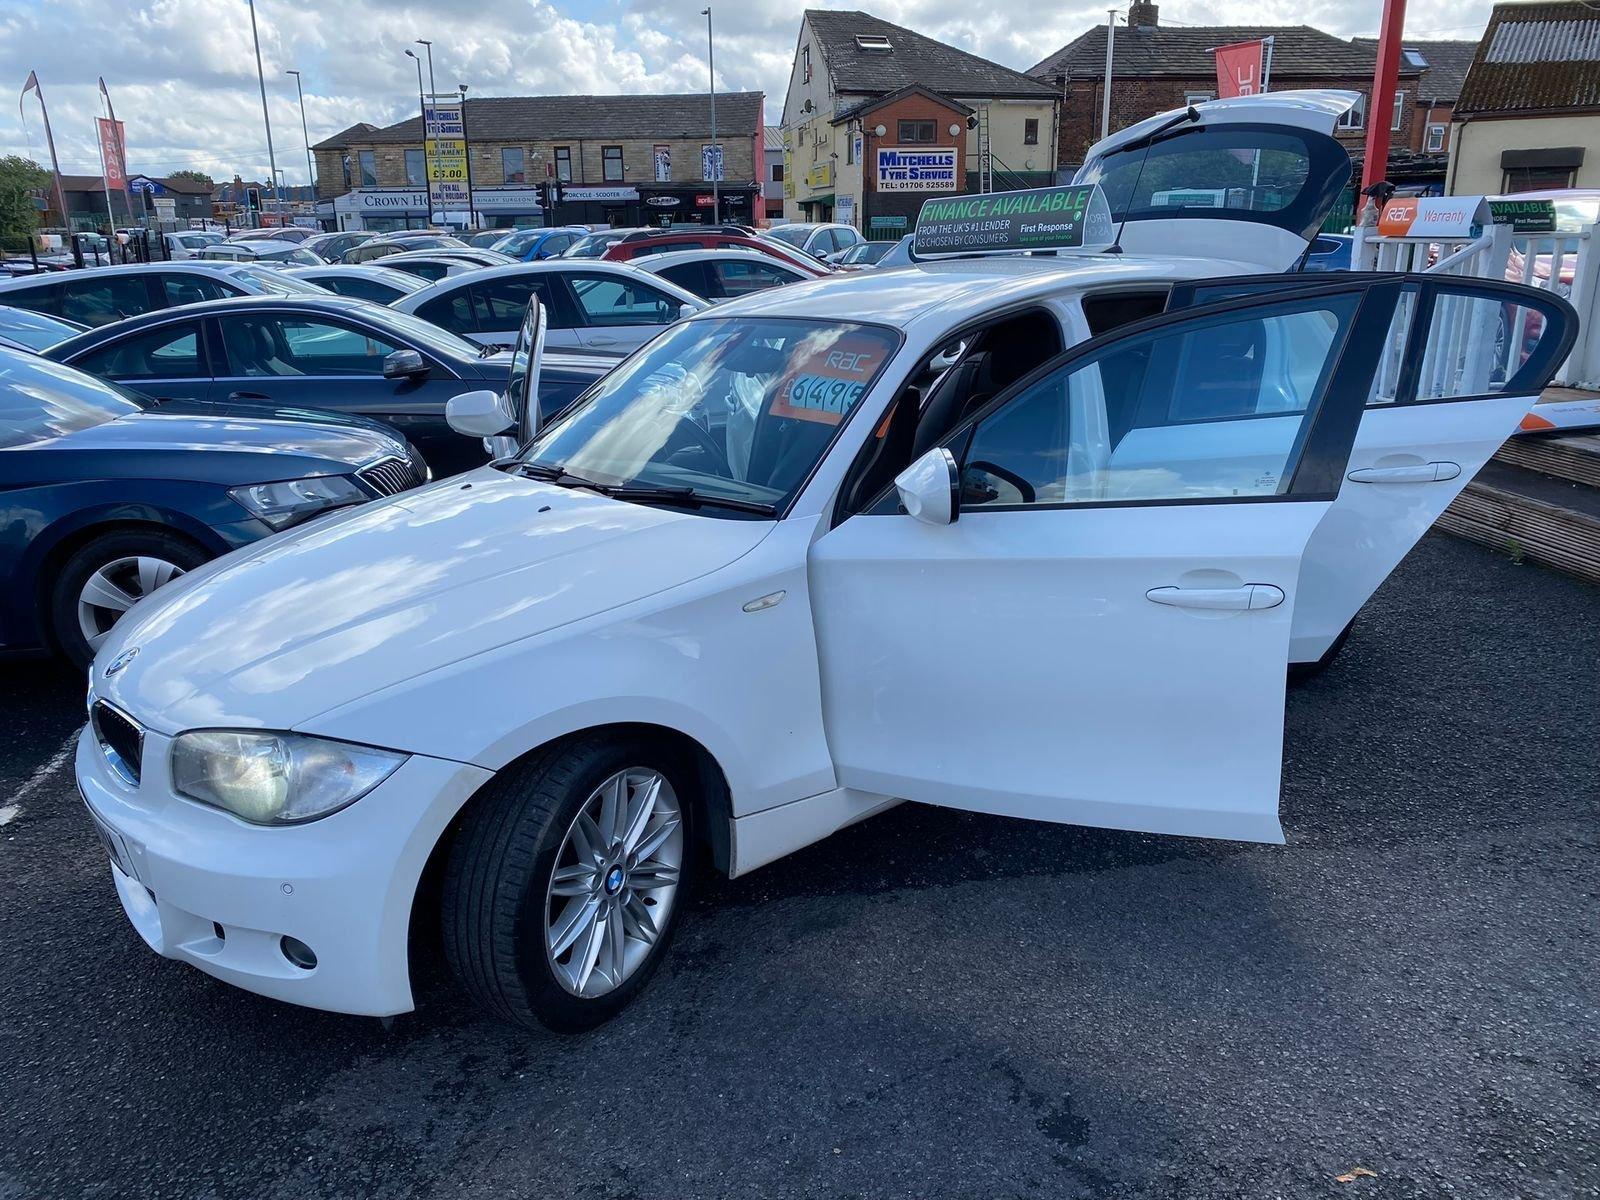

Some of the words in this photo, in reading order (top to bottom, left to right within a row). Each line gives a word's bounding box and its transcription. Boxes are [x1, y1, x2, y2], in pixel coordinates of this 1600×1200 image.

[426, 109, 459, 121] MTCHELLS
[441, 122, 462, 133] SERVICE
[879, 151, 953, 166] MITCHELLS
[879, 168, 907, 180] TYRE
[909, 167, 953, 180] SERVICE
[365, 195, 408, 206] CROWN
[445, 192, 468, 200] HOLIDAYS
[920, 199, 991, 222] FINANCE
[990, 190, 1089, 216] AVAILABLE
[1490, 202, 1554, 214] AVAILABLE
[1424, 209, 1465, 224] Warranty
[918, 222, 938, 235] FROM
[939, 222, 952, 234] THE
[953, 221, 970, 233] UK'S
[971, 221, 979, 232] #1
[980, 219, 1011, 231] LENDER
[1020, 224, 1036, 233] First
[1037, 222, 1074, 233] Response
[917, 238, 925, 248] AS
[925, 236, 954, 247] CHOSEN
[955, 235, 964, 245] BY
[964, 232, 1009, 245] CONSUMERS
